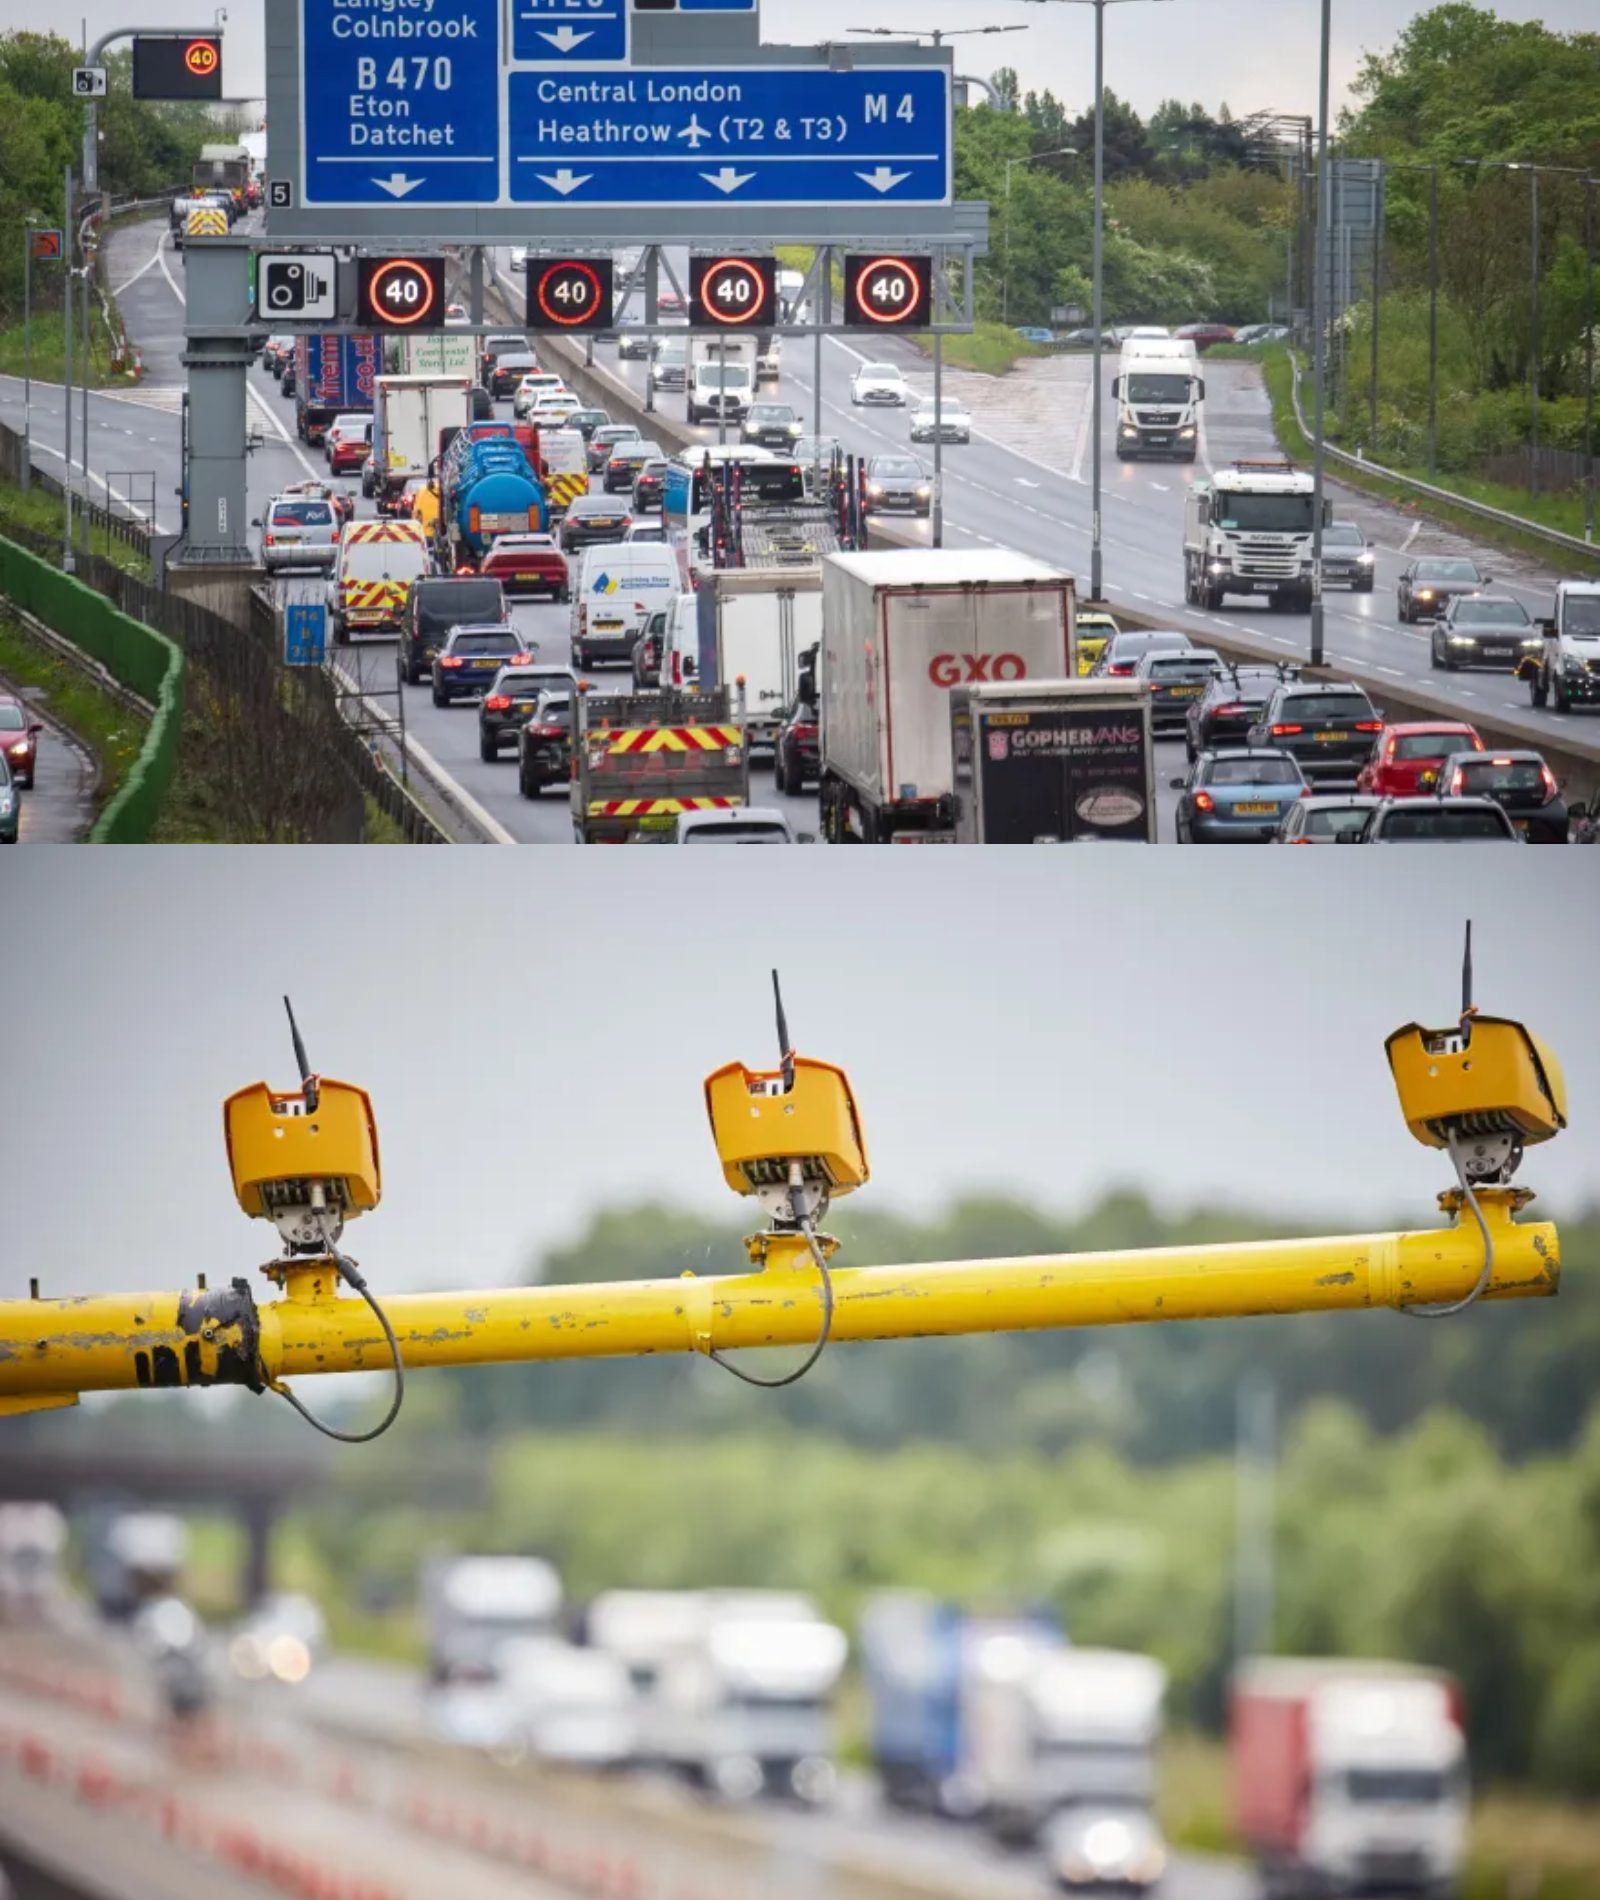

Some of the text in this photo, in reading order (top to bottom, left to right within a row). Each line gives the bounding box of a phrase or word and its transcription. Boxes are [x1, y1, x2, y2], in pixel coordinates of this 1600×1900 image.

[332, 14, 478, 38] Colnbrook
[190, 49, 213, 66] 40
[537, 80, 742, 103] Central London
[350, 95, 410, 117] Eton
[350, 123, 455, 145] Datchet
[538, 115, 848, 143] Heathrow (T2 & T3)
[273, 186, 287, 204] 5
[385, 278, 419, 304] 40
[553, 280, 587, 304] 40
[716, 278, 750, 302] 40
[871, 277, 905, 302] 40
[415, 346, 469, 356] Contiental
[929, 654, 1027, 688] GXO
